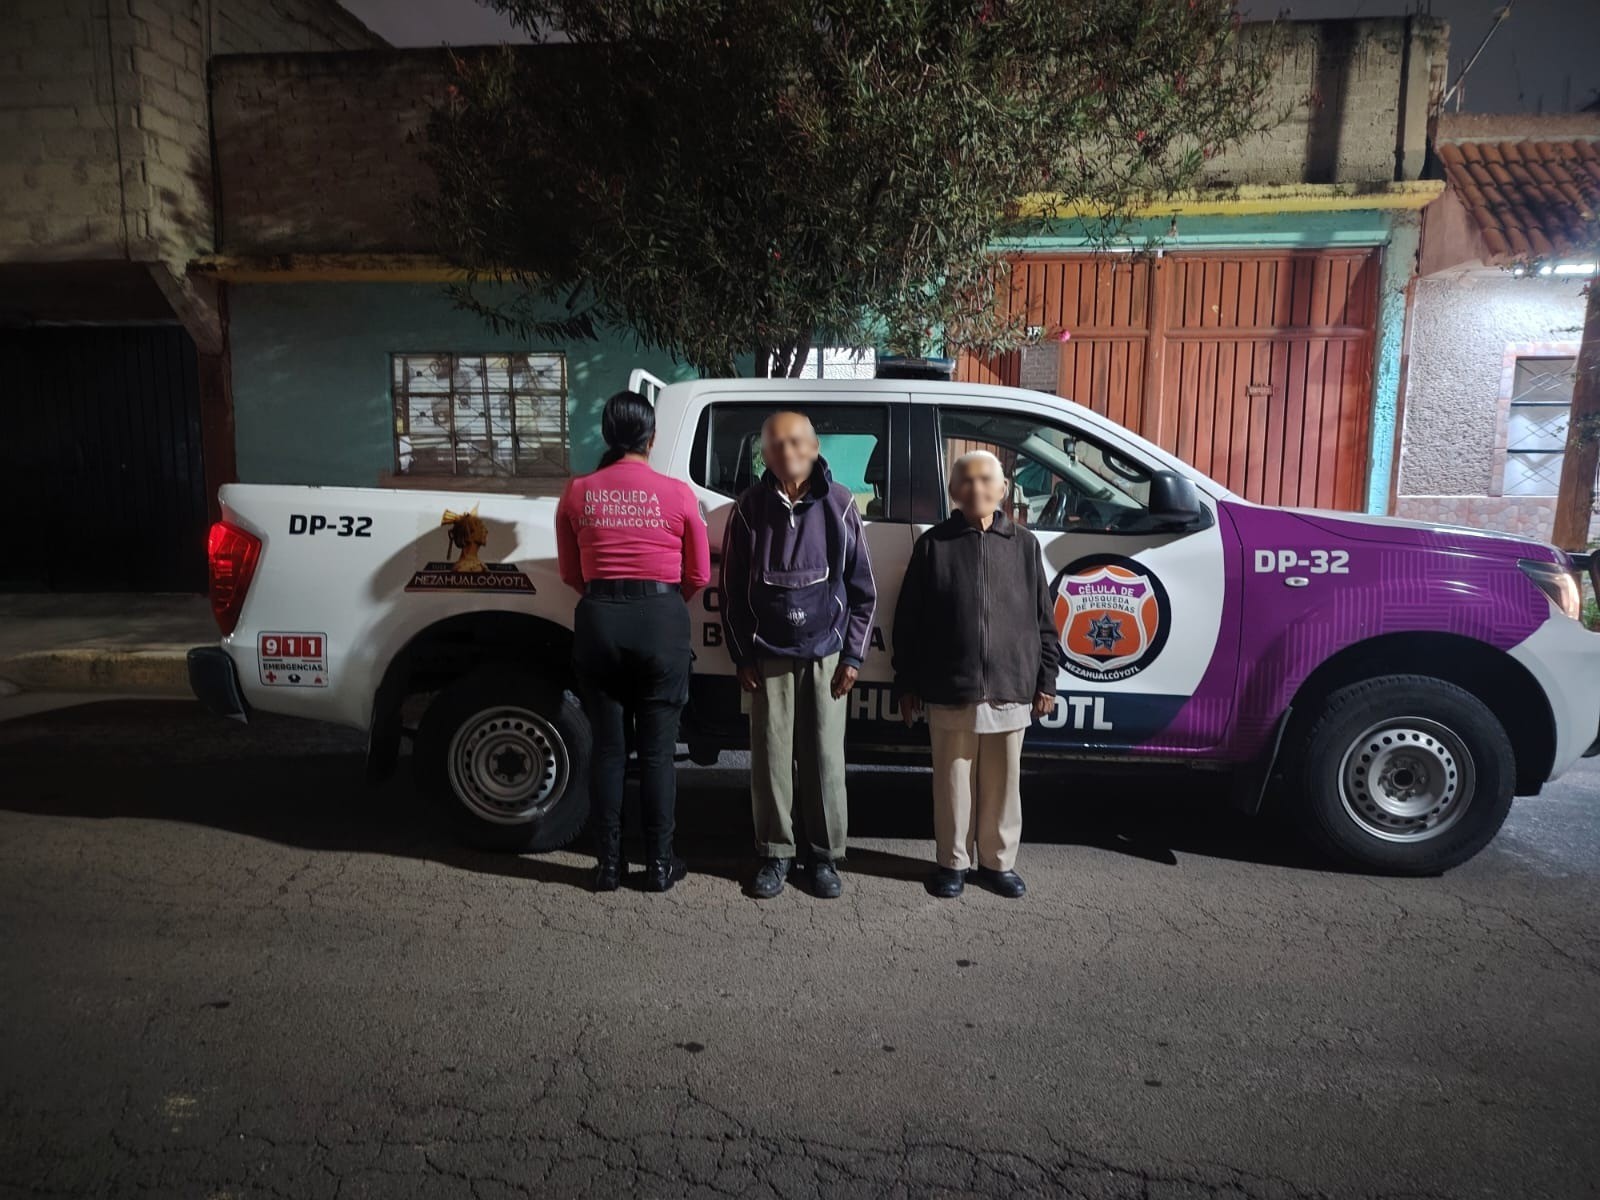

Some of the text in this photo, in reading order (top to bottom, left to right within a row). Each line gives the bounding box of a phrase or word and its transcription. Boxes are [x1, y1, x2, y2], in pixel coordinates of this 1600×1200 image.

[585, 504, 661, 517] DE PERSONAS
[289, 514, 373, 538] DP-32
[1254, 549, 1350, 574] DP-32
[1078, 583, 1134, 597] CÉLULA DE
[1076, 602, 1135, 613] DE PERSONAS
[264, 638, 317, 656] 911
[263, 663, 323, 672] EMERGENCIAS
